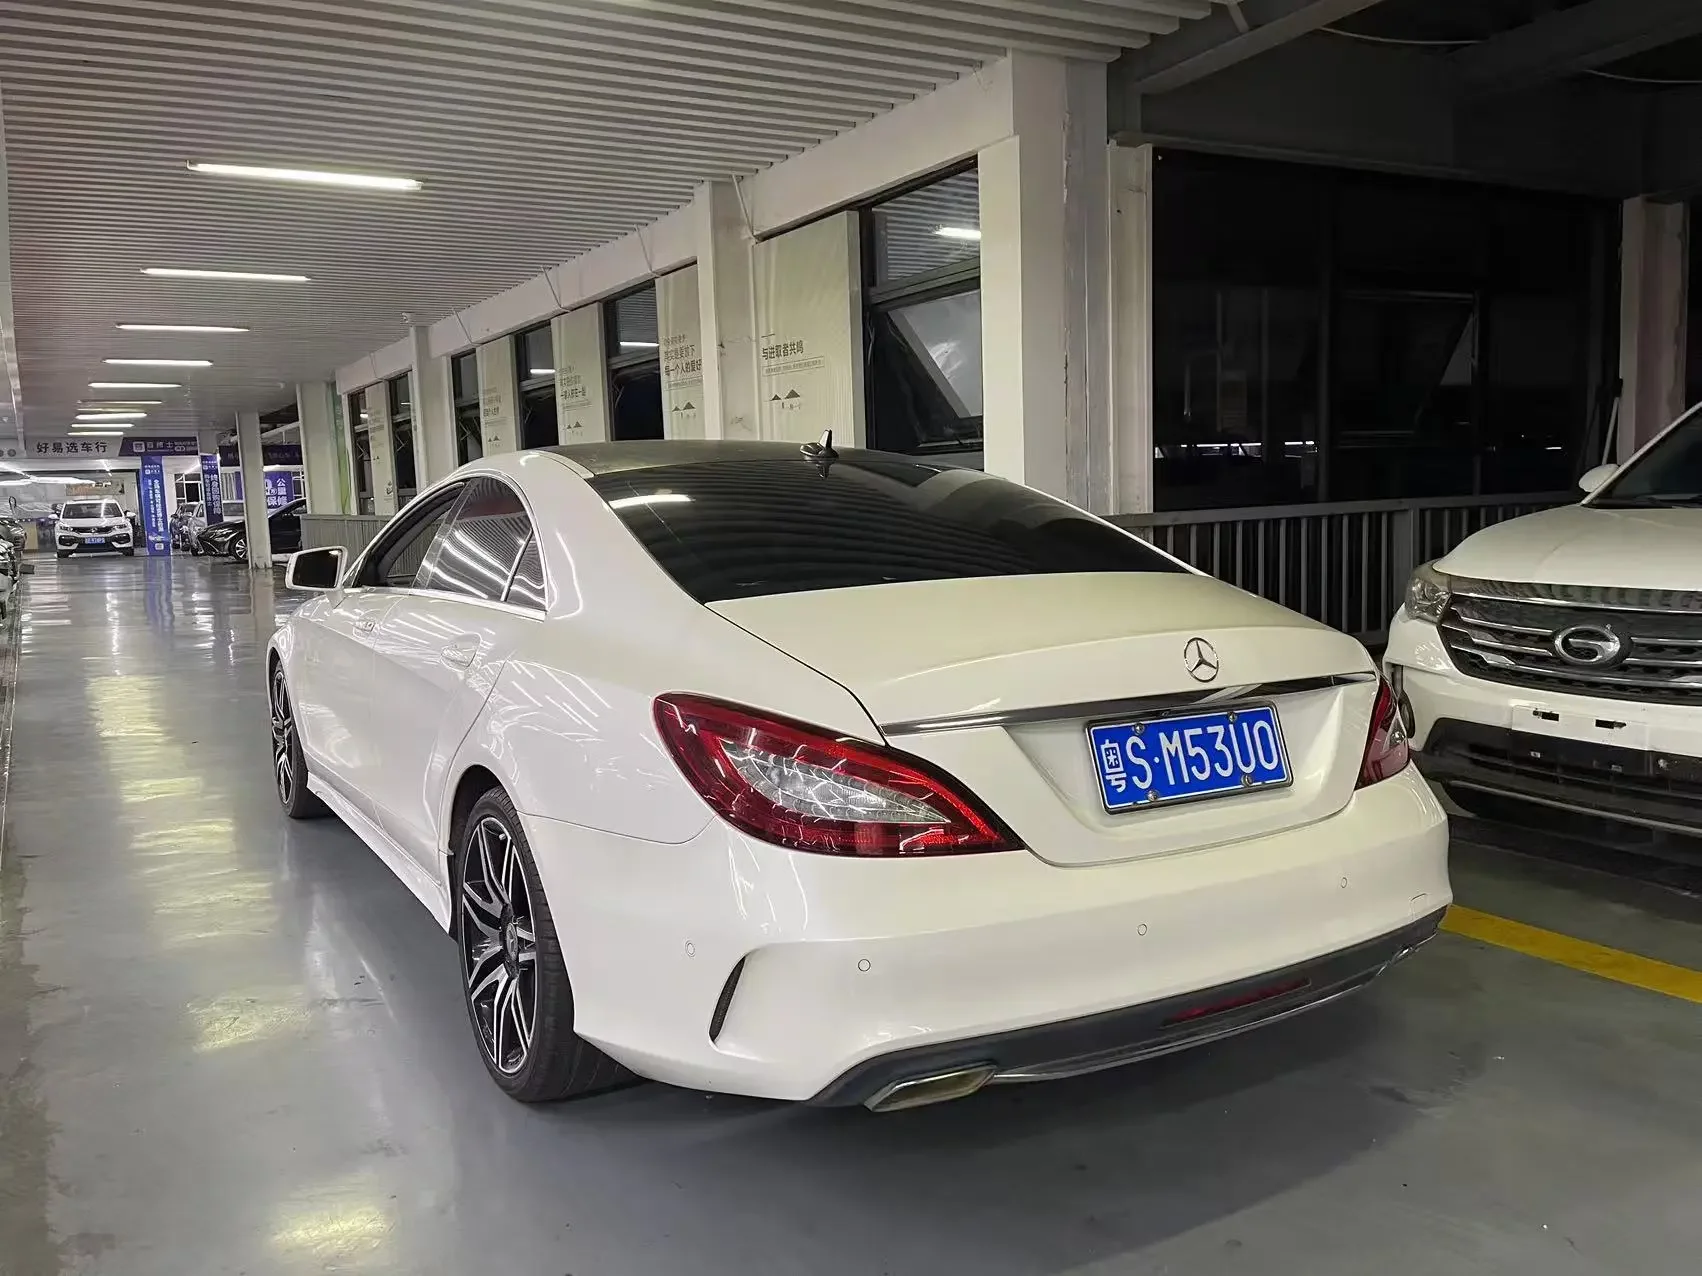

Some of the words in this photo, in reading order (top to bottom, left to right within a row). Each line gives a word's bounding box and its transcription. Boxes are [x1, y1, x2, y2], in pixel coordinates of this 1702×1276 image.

[36, 442, 108, 454] 好易选车行
[1100, 719, 1280, 793] 粤S·M53U0
